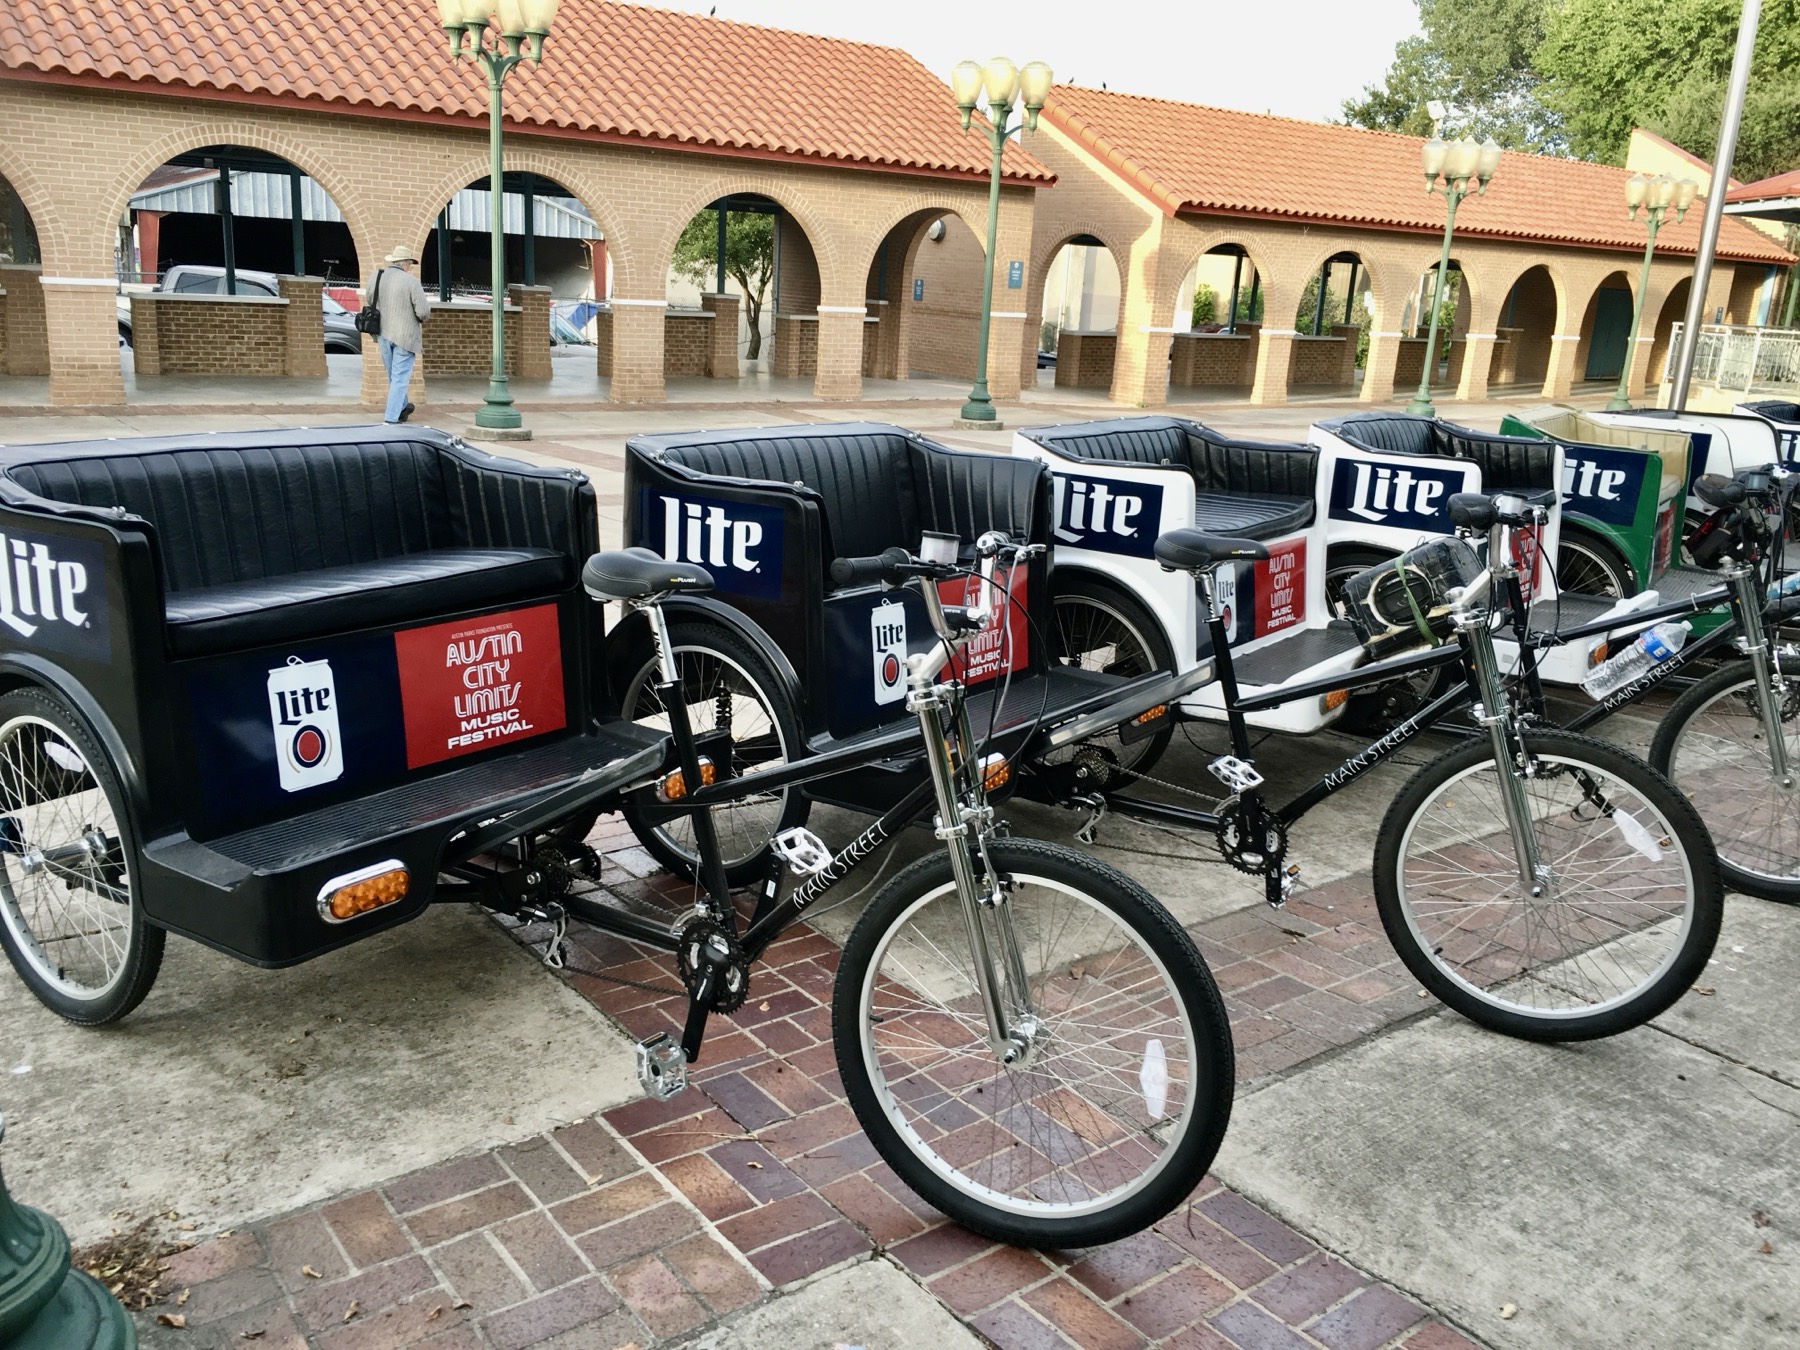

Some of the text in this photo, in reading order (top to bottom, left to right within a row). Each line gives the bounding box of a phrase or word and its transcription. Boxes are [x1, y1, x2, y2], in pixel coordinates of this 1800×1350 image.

[1347, 463, 1444, 522] Lite
[1562, 458, 1626, 504] ite
[1053, 476, 1143, 543] Lite
[1268, 552, 1295, 574] AUSTIN
[0, 532, 88, 637] Lite
[1218, 581, 1235, 604] Lite
[1273, 571, 1291, 590] CITY
[1270, 587, 1294, 609] LIMITS
[1271, 605, 1292, 618] MUSIC
[1267, 613, 1296, 629] FESTIVAL
[446, 631, 522, 667] AUSTIN
[875, 624, 904, 653] Lite
[463, 658, 510, 689] CITY
[1603, 653, 1685, 711] MAIN STREET
[274, 687, 331, 726] Lite
[454, 682, 522, 718] LIMITS
[448, 720, 533, 750] FESTIVAL
[461, 708, 520, 732] MUSIC
[1324, 715, 1419, 790] MAIN STREET
[793, 816, 888, 910] MAIN STREET
